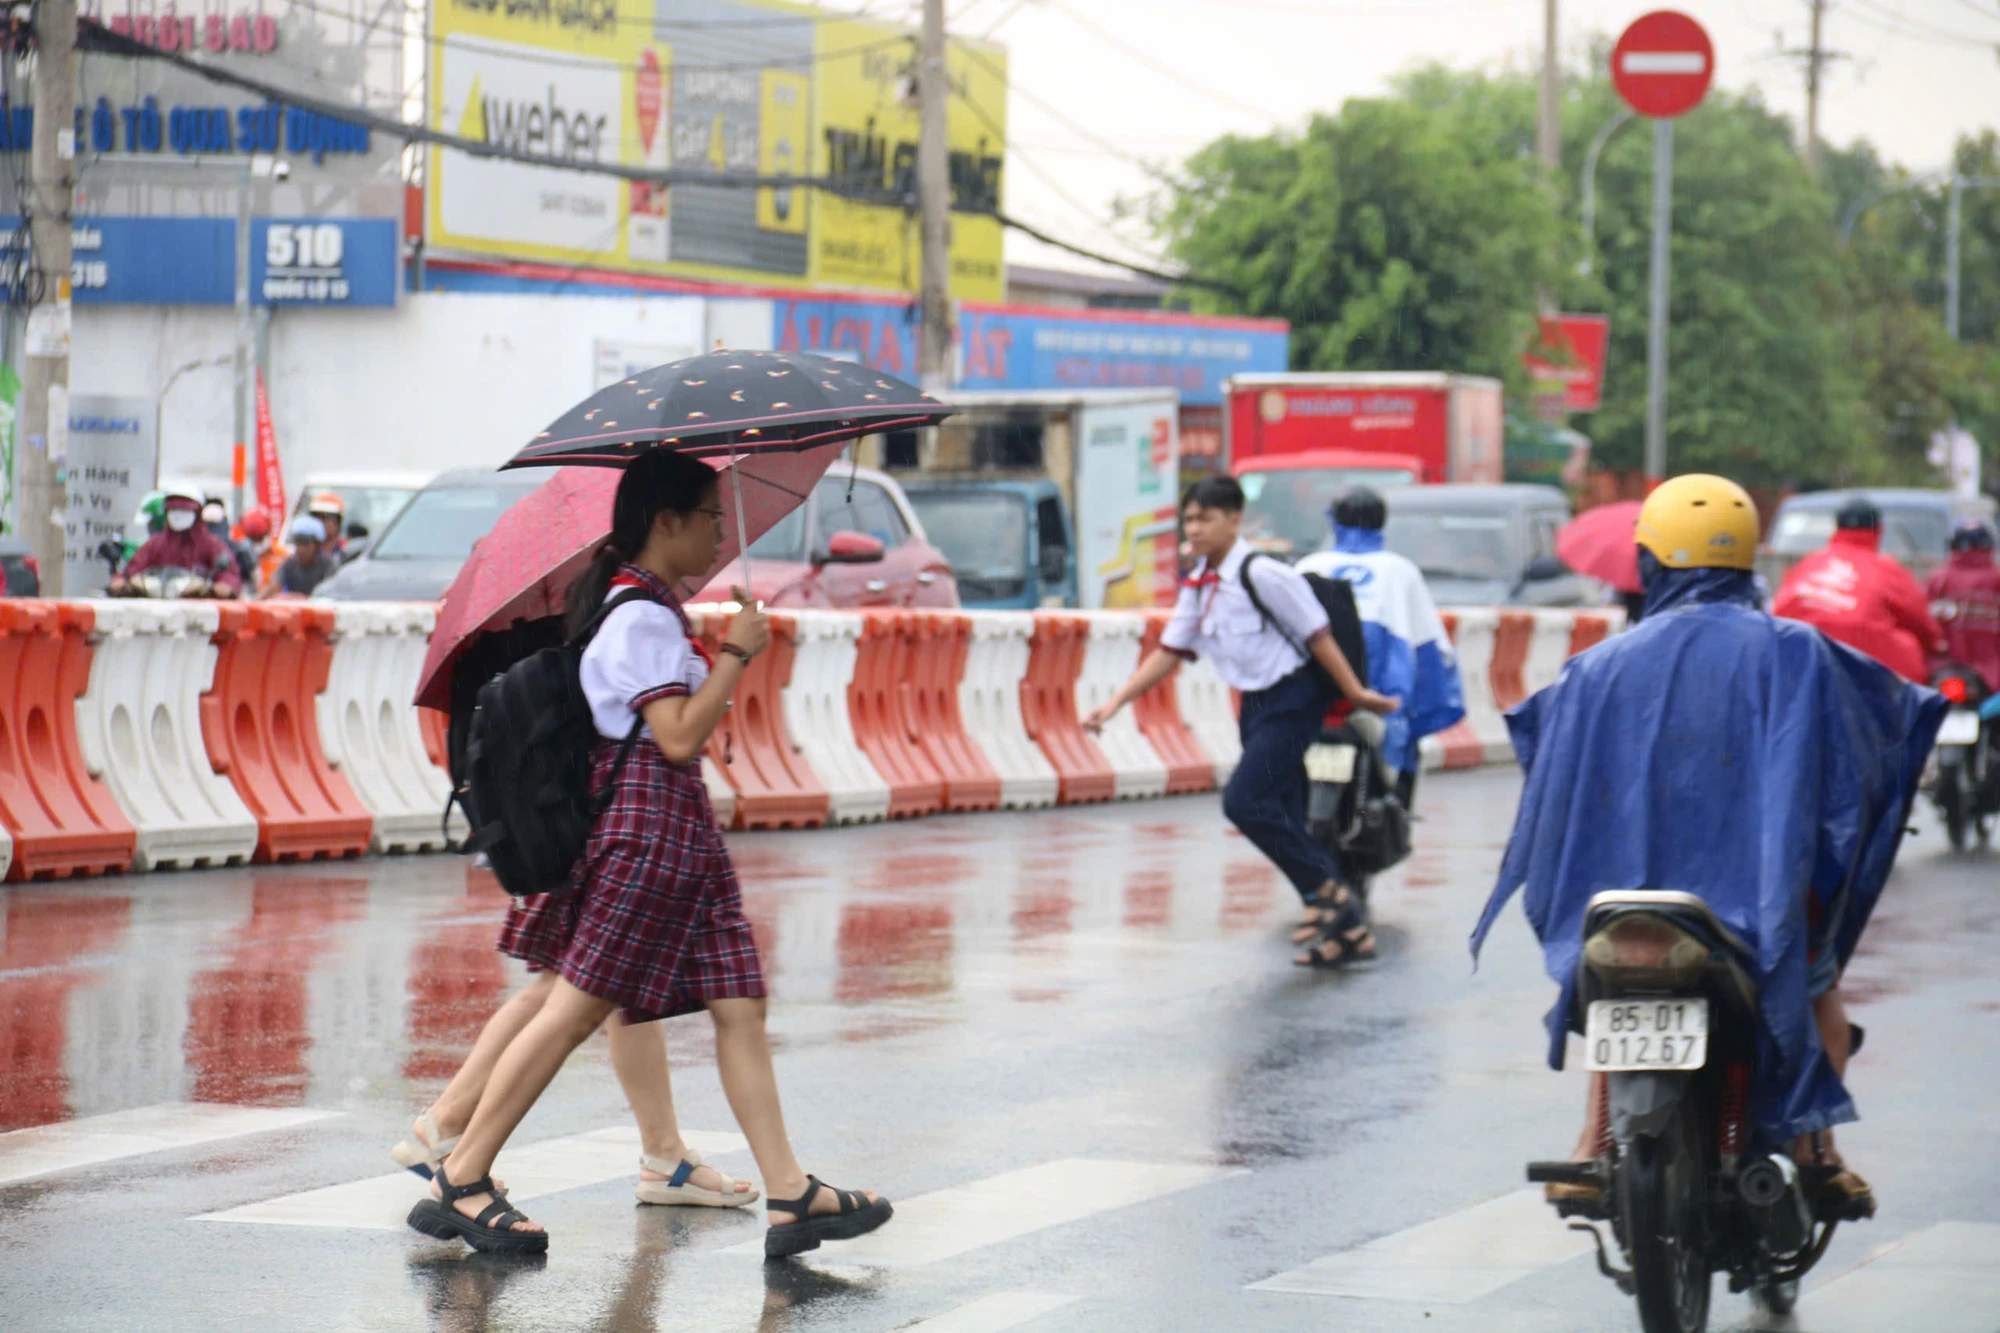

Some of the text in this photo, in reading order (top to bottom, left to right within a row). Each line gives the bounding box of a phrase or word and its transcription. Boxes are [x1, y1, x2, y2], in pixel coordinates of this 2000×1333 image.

[92, 95, 113, 153] Ô
[121, 95, 161, 153] TÔ
[170, 105, 230, 154] QUA
[266, 223, 343, 267] 510
